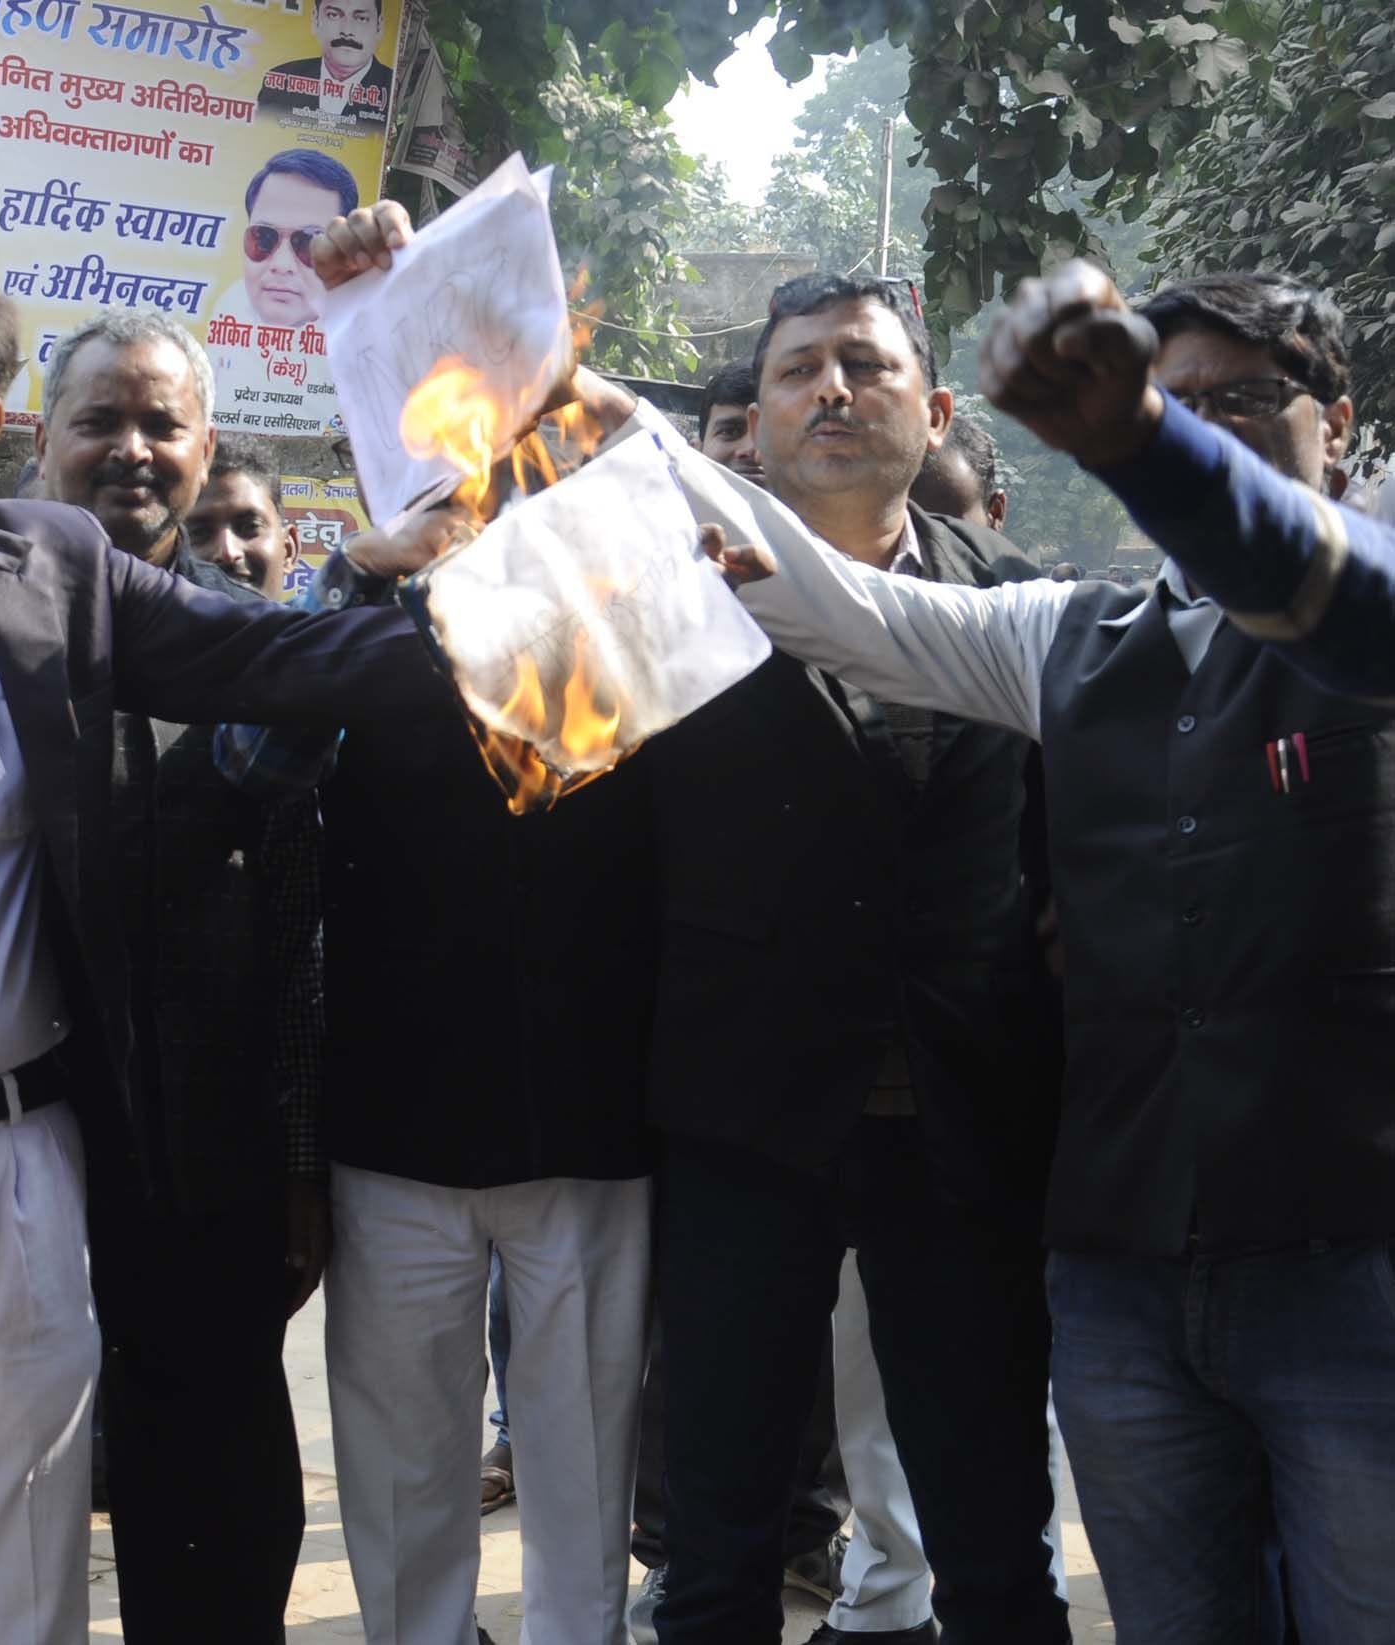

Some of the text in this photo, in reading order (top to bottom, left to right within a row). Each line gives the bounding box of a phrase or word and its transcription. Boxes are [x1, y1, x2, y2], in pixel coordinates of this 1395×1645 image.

[87, 5, 248, 70] समारोह
[59, 72, 126, 110] मुख्य
[130, 79, 255, 123] अतिथिगण
[264, 72, 285, 91] जय
[287, 75, 320, 96] प्रकाश
[323, 78, 345, 99] मिश्र
[178, 140, 214, 166] का
[115, 203, 227, 249] स्वागत
[3, 254, 209, 314] एवं अभिनन्दन
[207, 313, 253, 348] अंकित
[257, 325, 295, 359] कुमार
[266, 355, 309, 387] (केशू)
[234, 386, 304, 406] प्रदेश उपाध्यक्ष
[243, 413, 262, 427] बार
[263, 413, 321, 432] एसोसिएशन
[295, 511, 345, 552] हेतु
